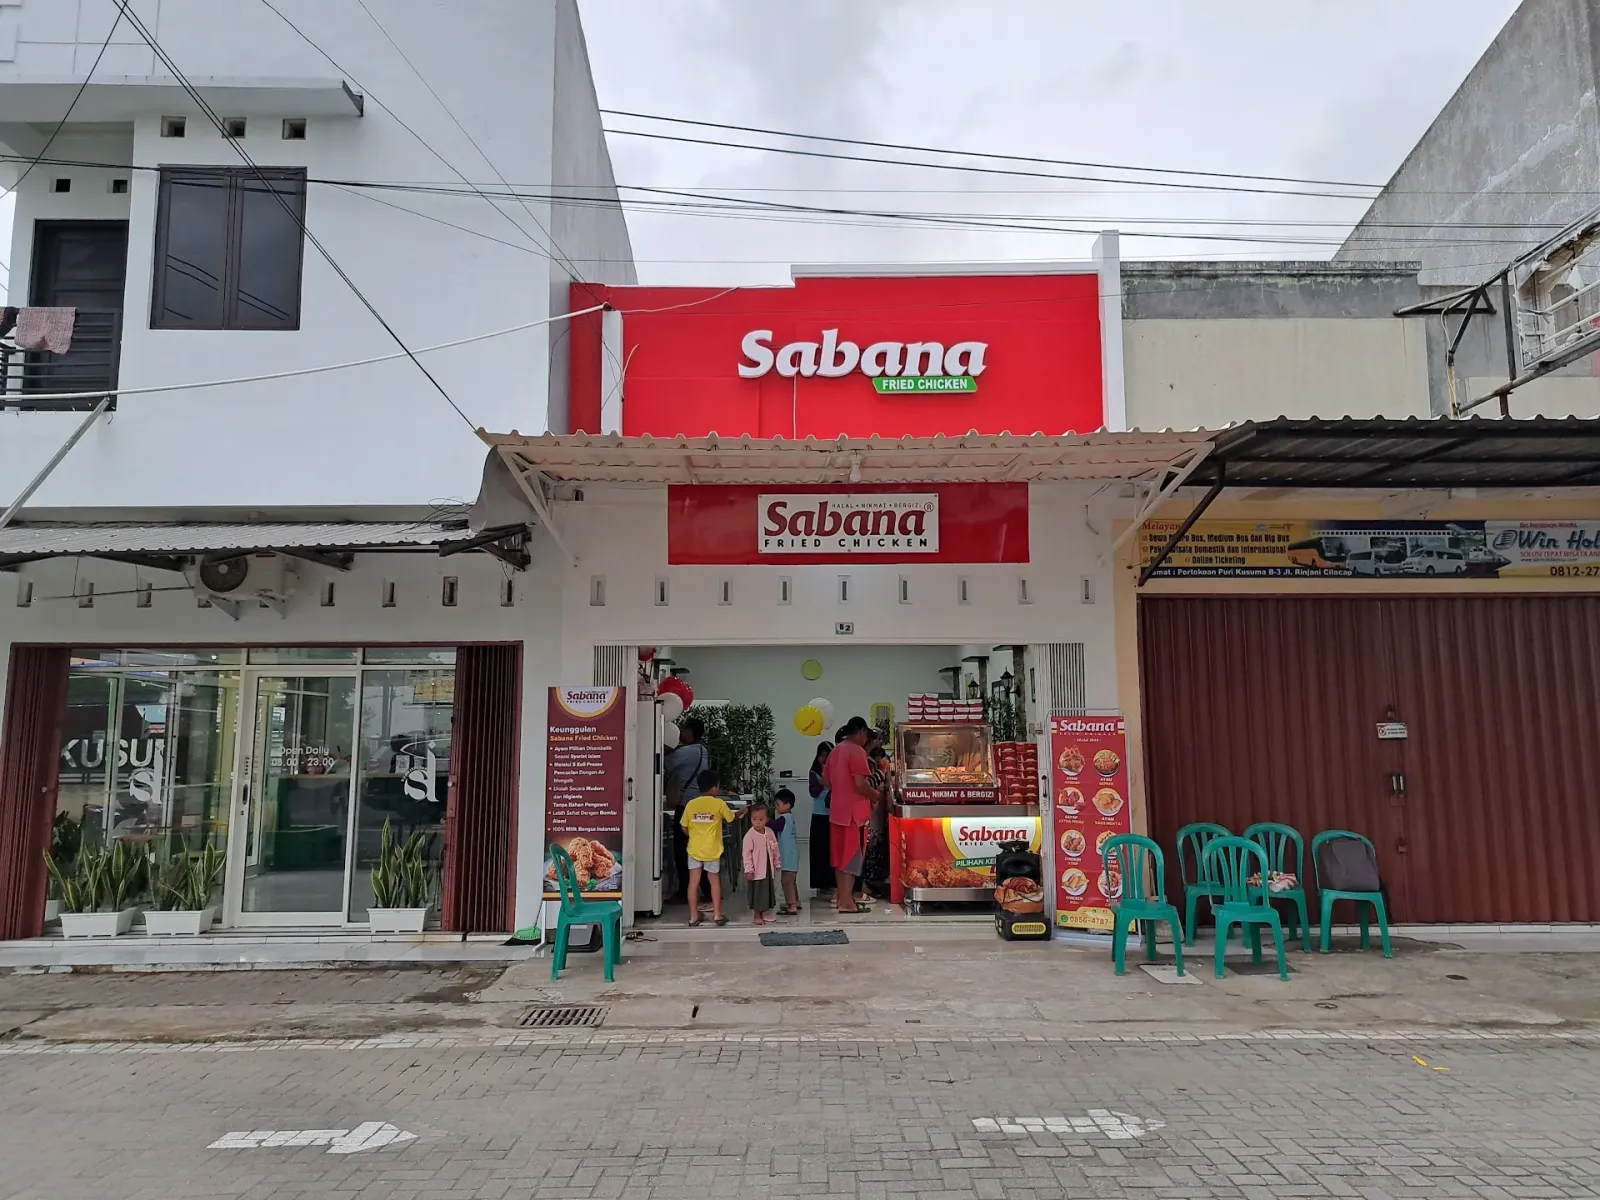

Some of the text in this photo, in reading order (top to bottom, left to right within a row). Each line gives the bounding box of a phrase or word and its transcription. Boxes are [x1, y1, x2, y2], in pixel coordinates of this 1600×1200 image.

[737, 328, 988, 378] Sabana
[882, 378, 968, 390] FRIED CHICKEN
[764, 500, 926, 536] Sabana
[764, 538, 928, 548] FRIED CHICKEN
[1149, 534, 1167, 542] Sewa
[1208, 534, 1234, 542] Medium
[1236, 534, 1248, 542] Bus
[1264, 534, 1276, 543] Big
[1518, 530, 1560, 548] Win
[1240, 545, 1286, 554] Internasional
[1192, 556, 1246, 565] Online Ticketing
[1294, 568, 1322, 576] Rinjani
[1323, 568, 1352, 576] Cilacap
[1550, 566, 1600, 576] 0812-27
[566, 690, 606, 700] Sabana
[550, 726, 597, 734] Keunggulan
[1060, 720, 1115, 732] Sabana
[280, 746, 330, 756] Open Daily
[308, 758, 334, 766] 23.00
[906, 791, 930, 799] HALAL,
[958, 826, 1027, 842] Sabana
[956, 859, 984, 867] PILIHAN
